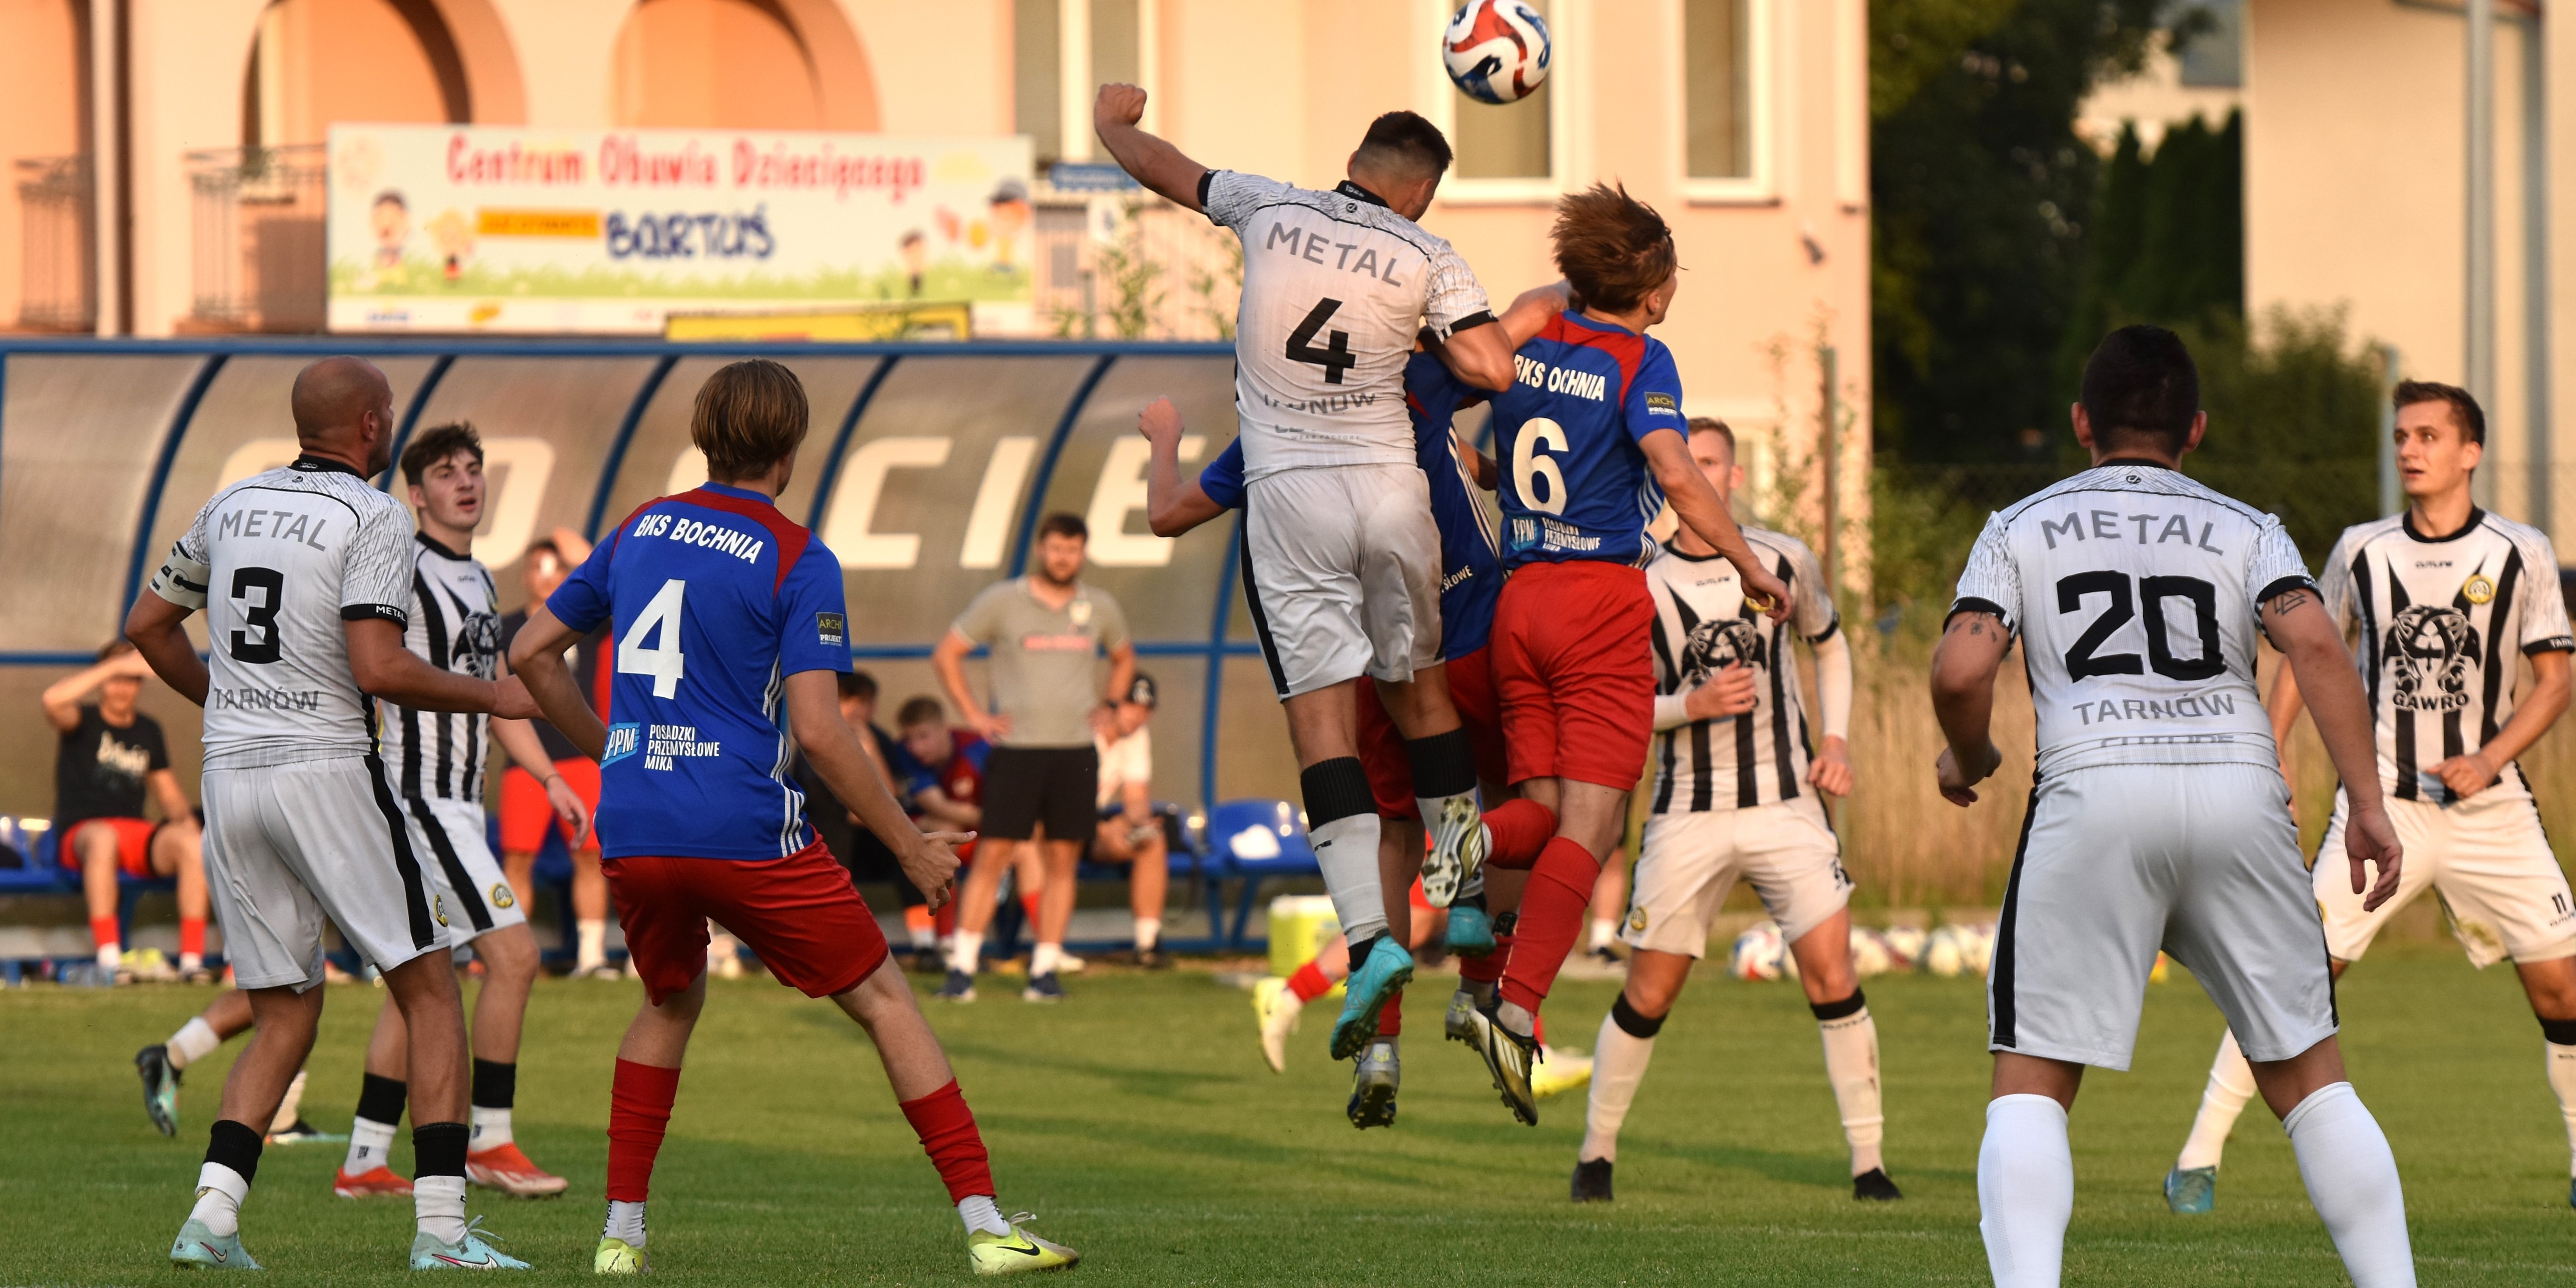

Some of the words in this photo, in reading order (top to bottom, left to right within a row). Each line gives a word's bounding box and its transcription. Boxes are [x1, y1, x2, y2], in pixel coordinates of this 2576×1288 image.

[447, 134, 585, 184] Centrum
[599, 135, 717, 186] Obuwia
[1266, 222, 1401, 287] METAL
[1286, 297, 1356, 384] 4
[1514, 354, 1546, 388] BKS
[1513, 417, 1569, 516] 6
[219, 510, 326, 551] METAL
[634, 515, 671, 537] BKS
[669, 518, 763, 564] BOCHNIA
[2041, 510, 2223, 556] METAL
[231, 567, 284, 664] 3
[376, 605, 406, 621] METAL
[819, 619, 841, 629] ARCHI
[2057, 570, 2228, 682] 20
[618, 579, 685, 699] 4
[214, 686, 319, 711] TARNÓW
[2073, 693, 2235, 725] TARNÓW
[2393, 691, 2469, 710] GAWRO
[604, 728, 635, 760] PPM
[647, 740, 720, 756] PRZEMYSŁOWE
[649, 724, 695, 741] POSADZKI
[644, 755, 673, 771] MIKA
[2551, 893, 2567, 914] 11
